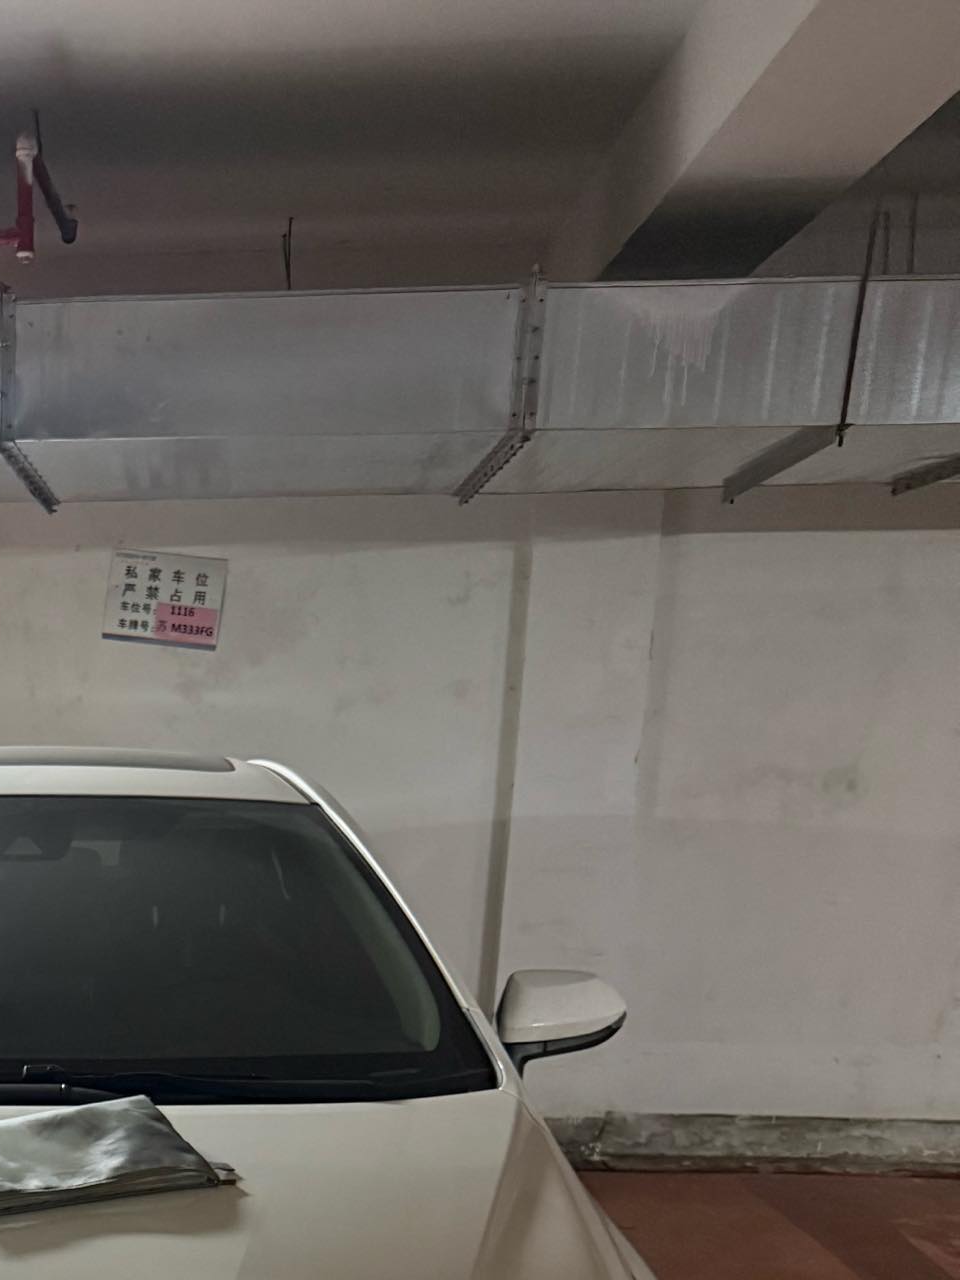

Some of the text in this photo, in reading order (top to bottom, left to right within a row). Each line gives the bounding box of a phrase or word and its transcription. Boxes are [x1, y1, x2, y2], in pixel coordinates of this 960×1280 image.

[125, 565, 209, 587] 私家车位
[122, 583, 207, 606] 严禁占用
[170, 606, 195, 617] 1116
[171, 623, 214, 637] M333FG
